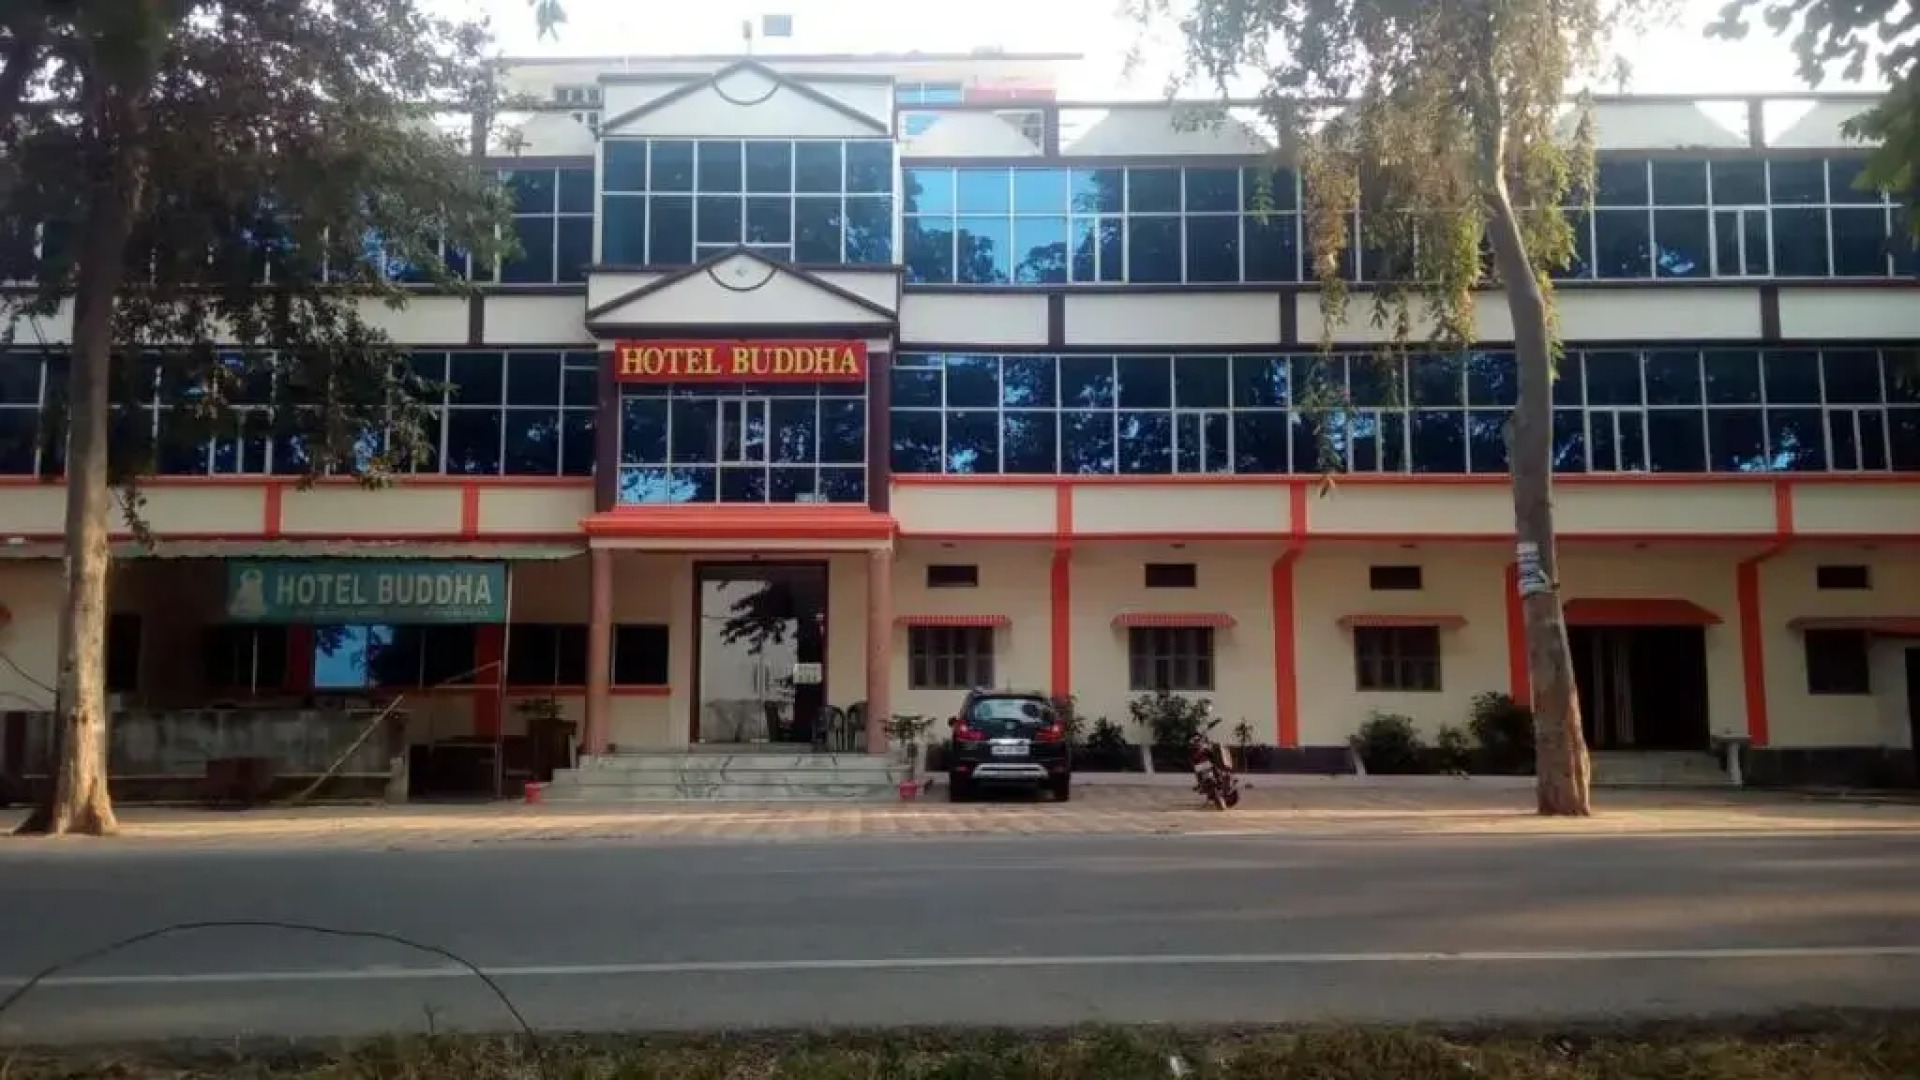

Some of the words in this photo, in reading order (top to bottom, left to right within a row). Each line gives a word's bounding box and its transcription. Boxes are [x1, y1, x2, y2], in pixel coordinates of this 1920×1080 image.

[621, 347, 721, 375] HOTEL
[732, 346, 859, 375] BUDDHA
[276, 573, 369, 605] HOTEL
[378, 573, 492, 605] BUDDHA
